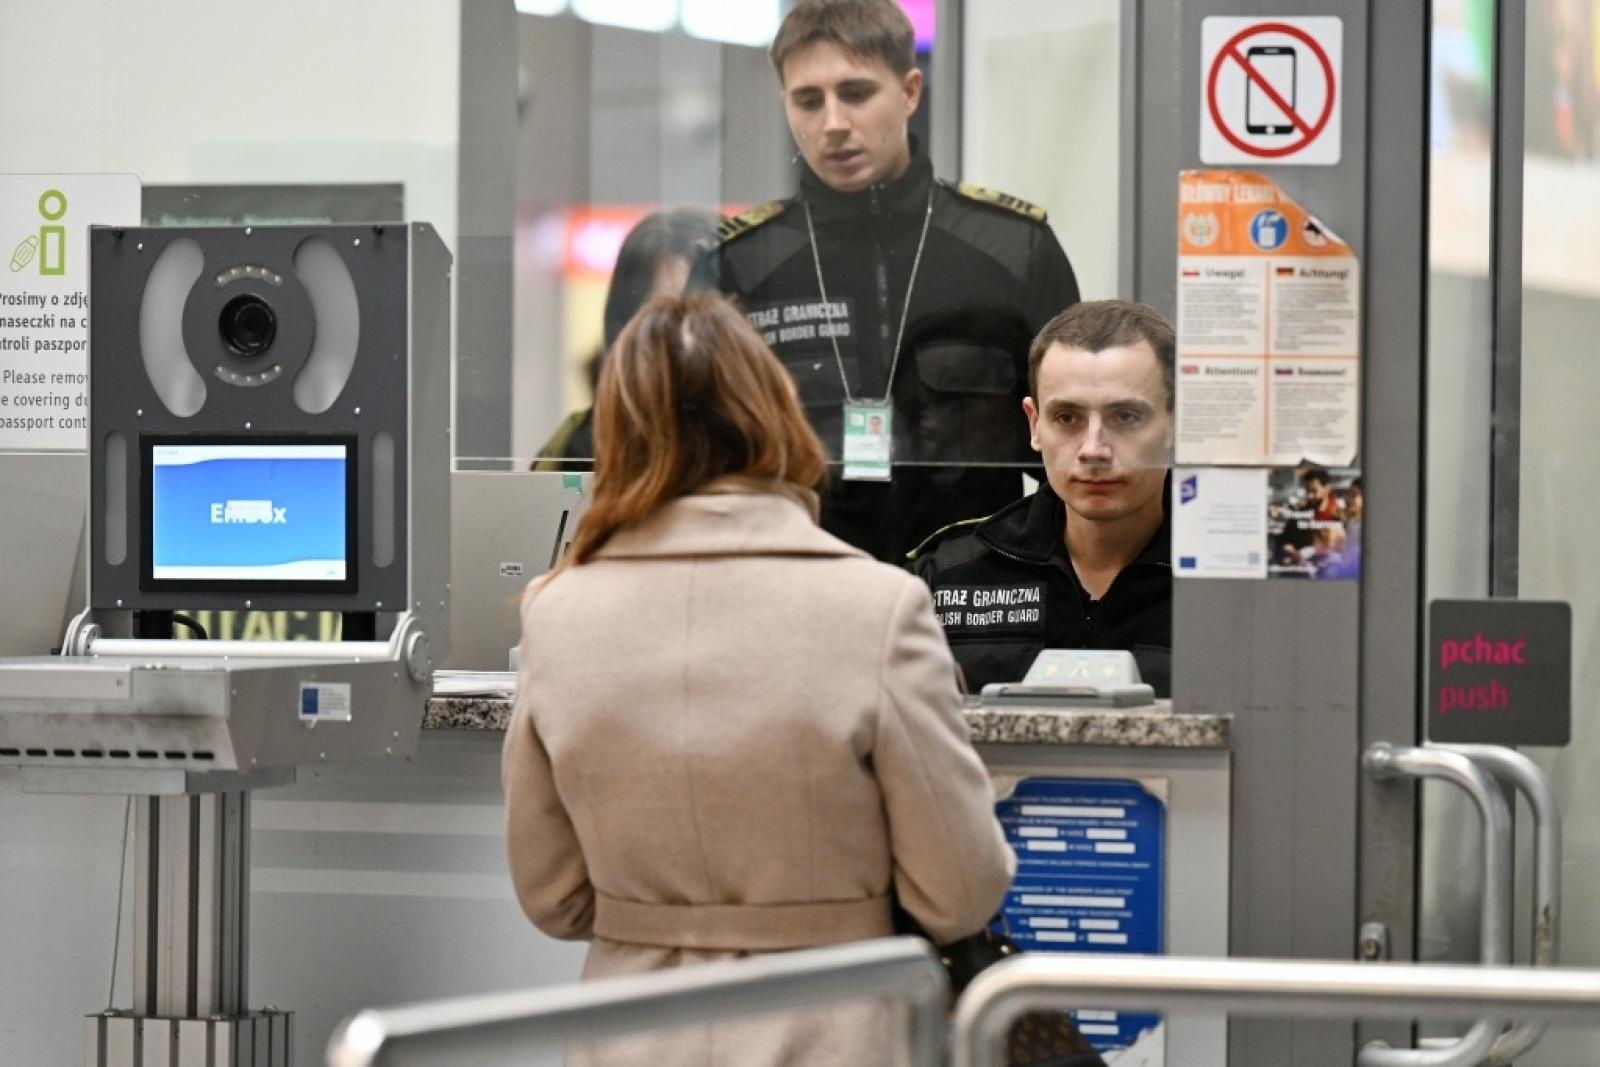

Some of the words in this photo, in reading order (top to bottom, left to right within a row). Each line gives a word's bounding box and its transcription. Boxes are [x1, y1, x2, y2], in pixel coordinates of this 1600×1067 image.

[51, 295, 58, 305] o
[783, 303, 848, 322] GRANICZNA
[60, 317, 75, 328] na
[0, 336, 29, 351] troli
[3, 369, 46, 384] Please
[14, 392, 70, 410] covering
[973, 587, 1040, 606] GRANICZNA
[966, 610, 1003, 626] BORDER
[1008, 608, 1040, 624] GUARD
[1440, 631, 1527, 671] pchać
[1439, 676, 1510, 716] push
